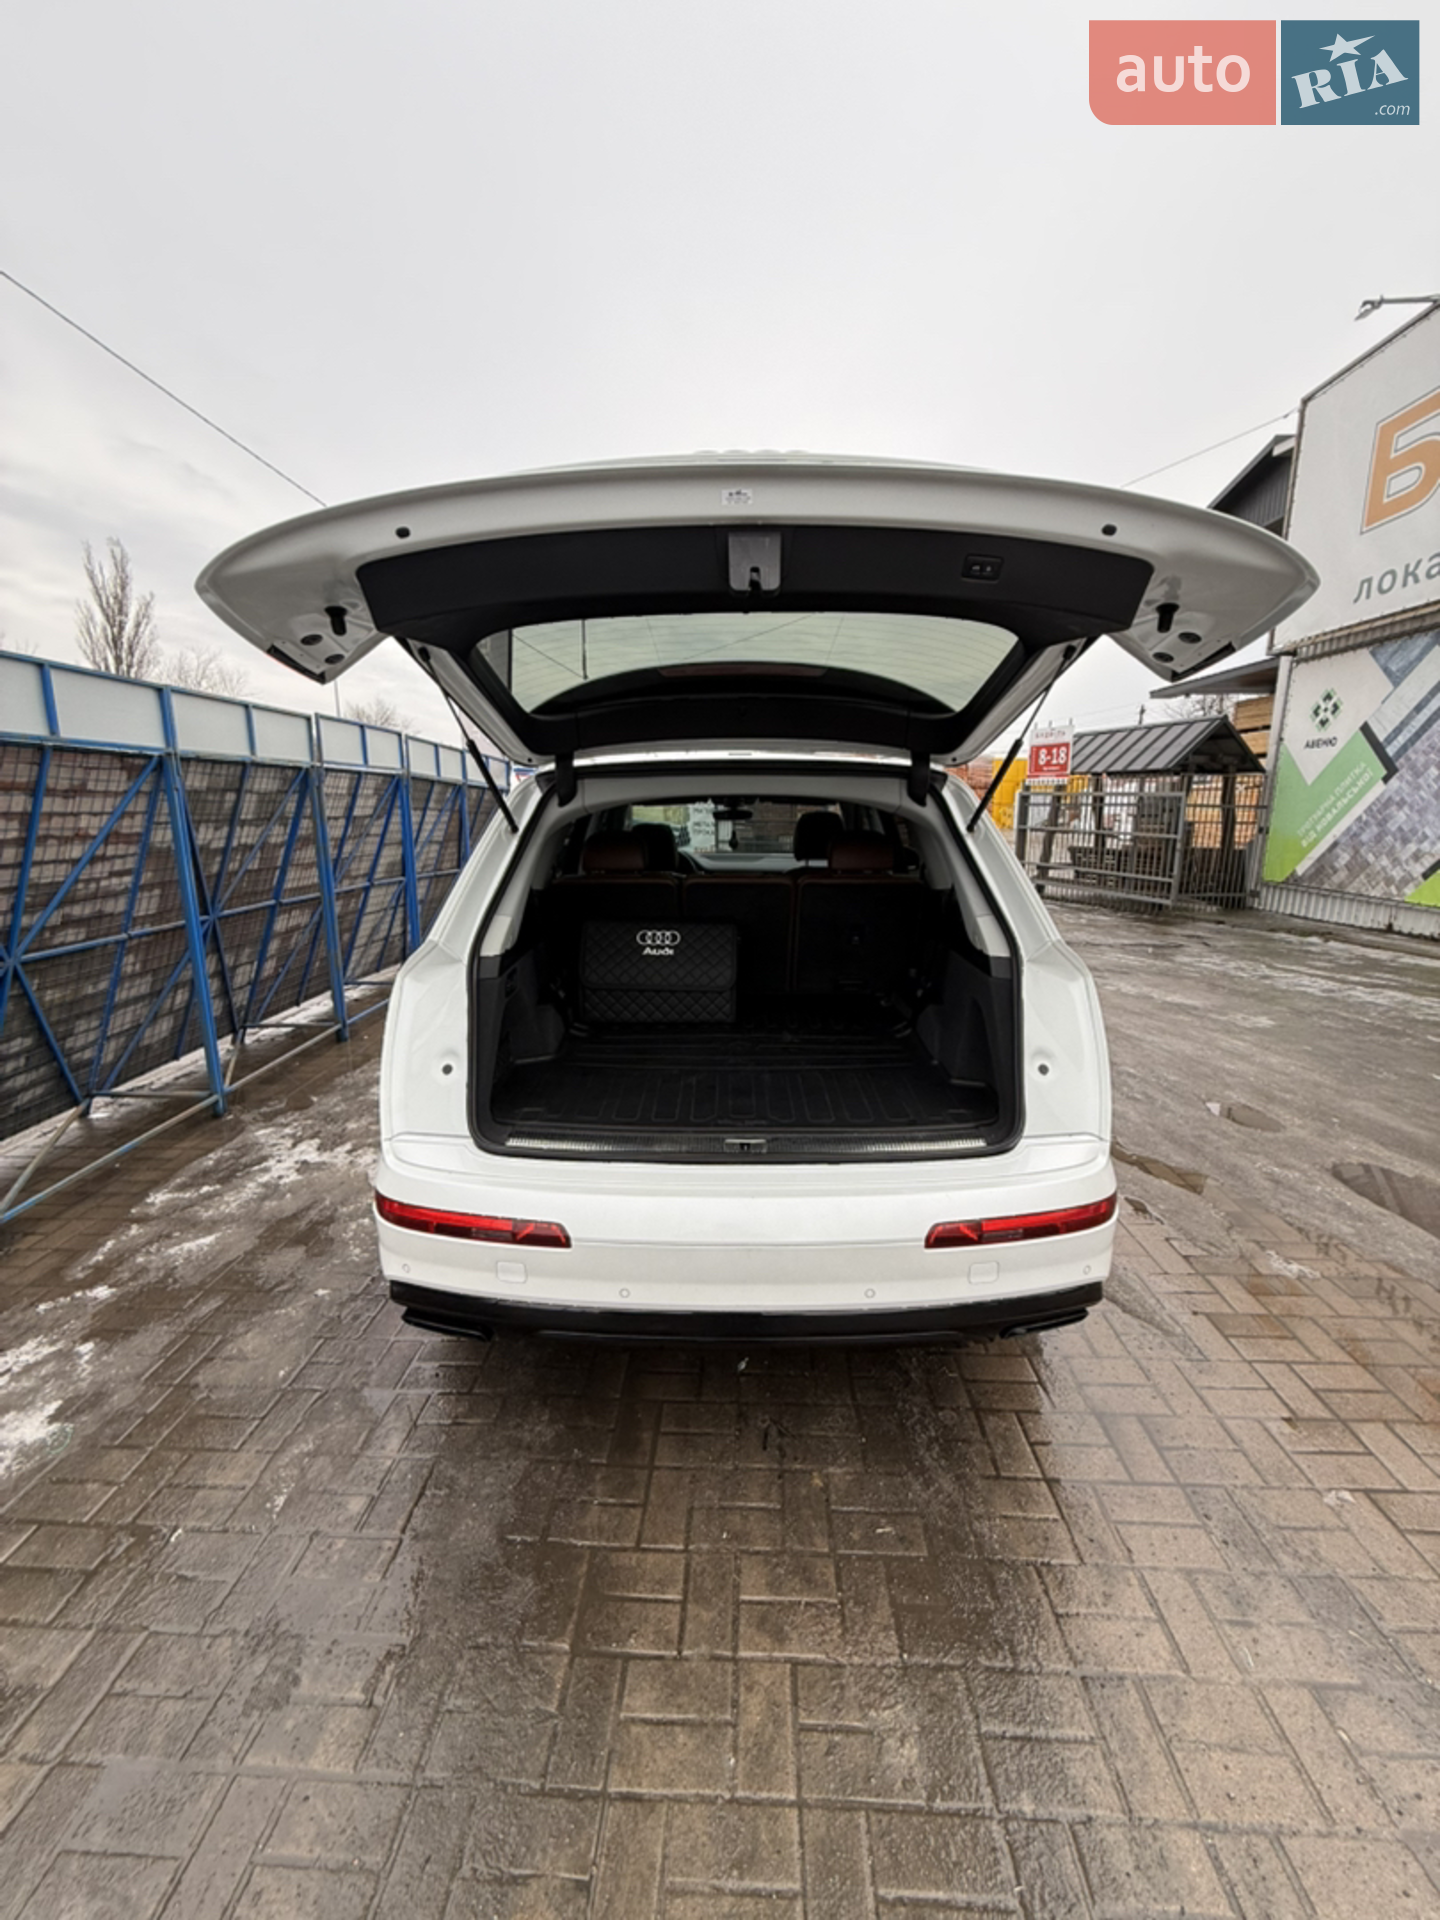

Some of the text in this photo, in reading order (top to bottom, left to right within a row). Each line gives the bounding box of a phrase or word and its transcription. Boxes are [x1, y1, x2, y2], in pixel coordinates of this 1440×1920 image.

[1303, 736, 1338, 749] АВЕНЮ
[1038, 746, 1068, 766] 8-18
[642, 946, 675, 956] Audi
